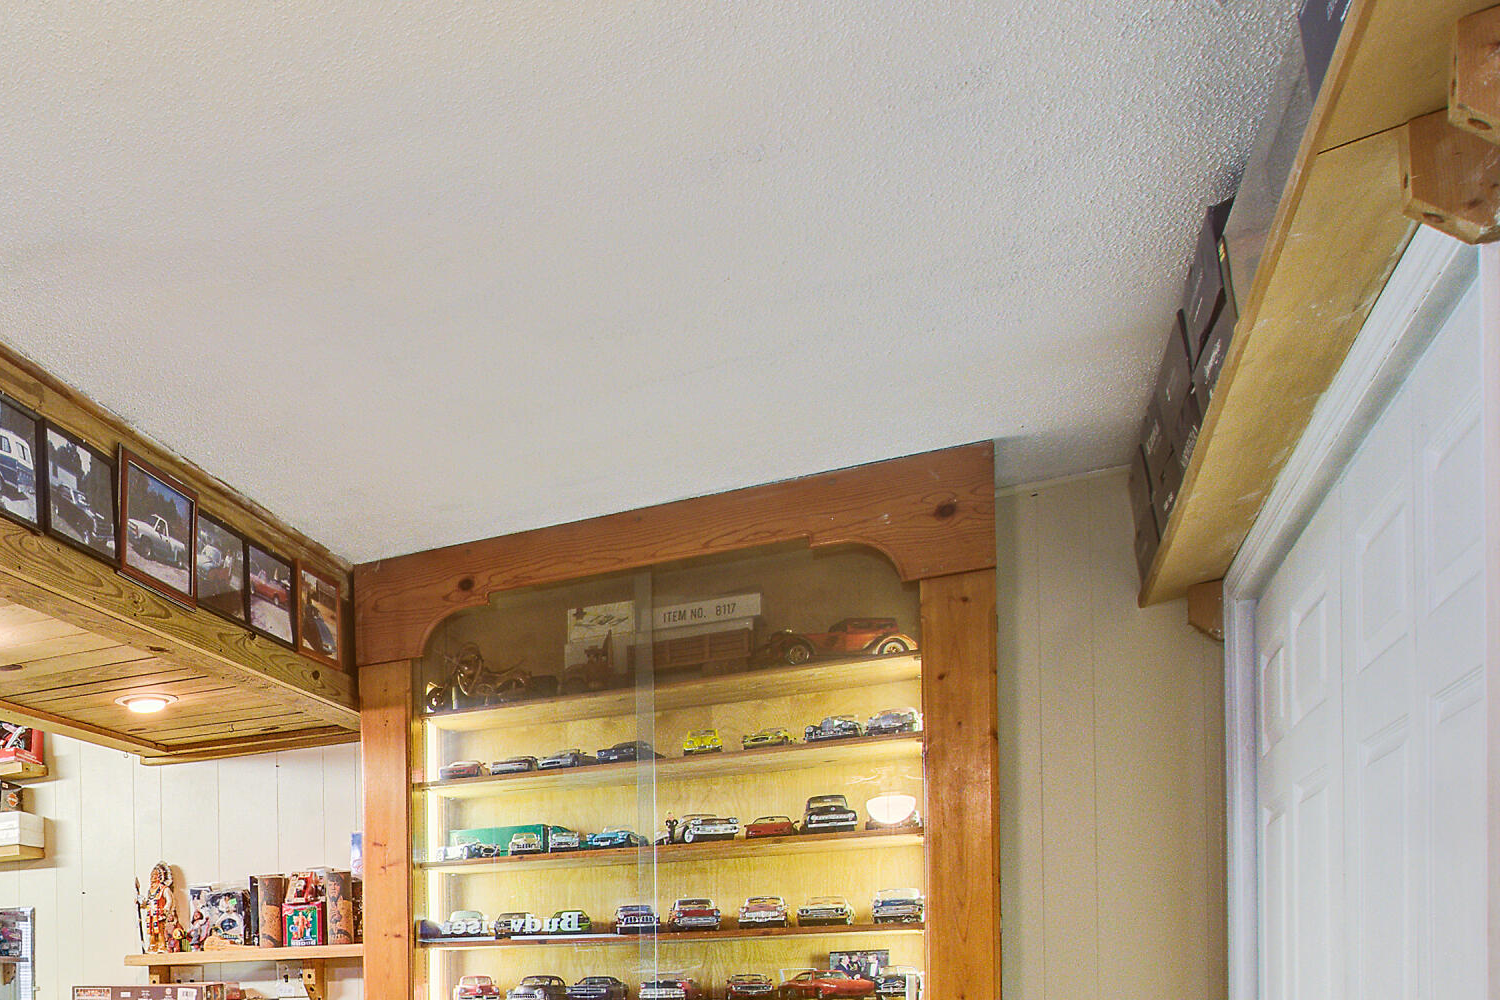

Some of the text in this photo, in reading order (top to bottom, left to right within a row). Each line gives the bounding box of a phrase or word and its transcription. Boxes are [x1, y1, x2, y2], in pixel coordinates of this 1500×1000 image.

[663, 603, 736, 623] ITEM NO. 8117
